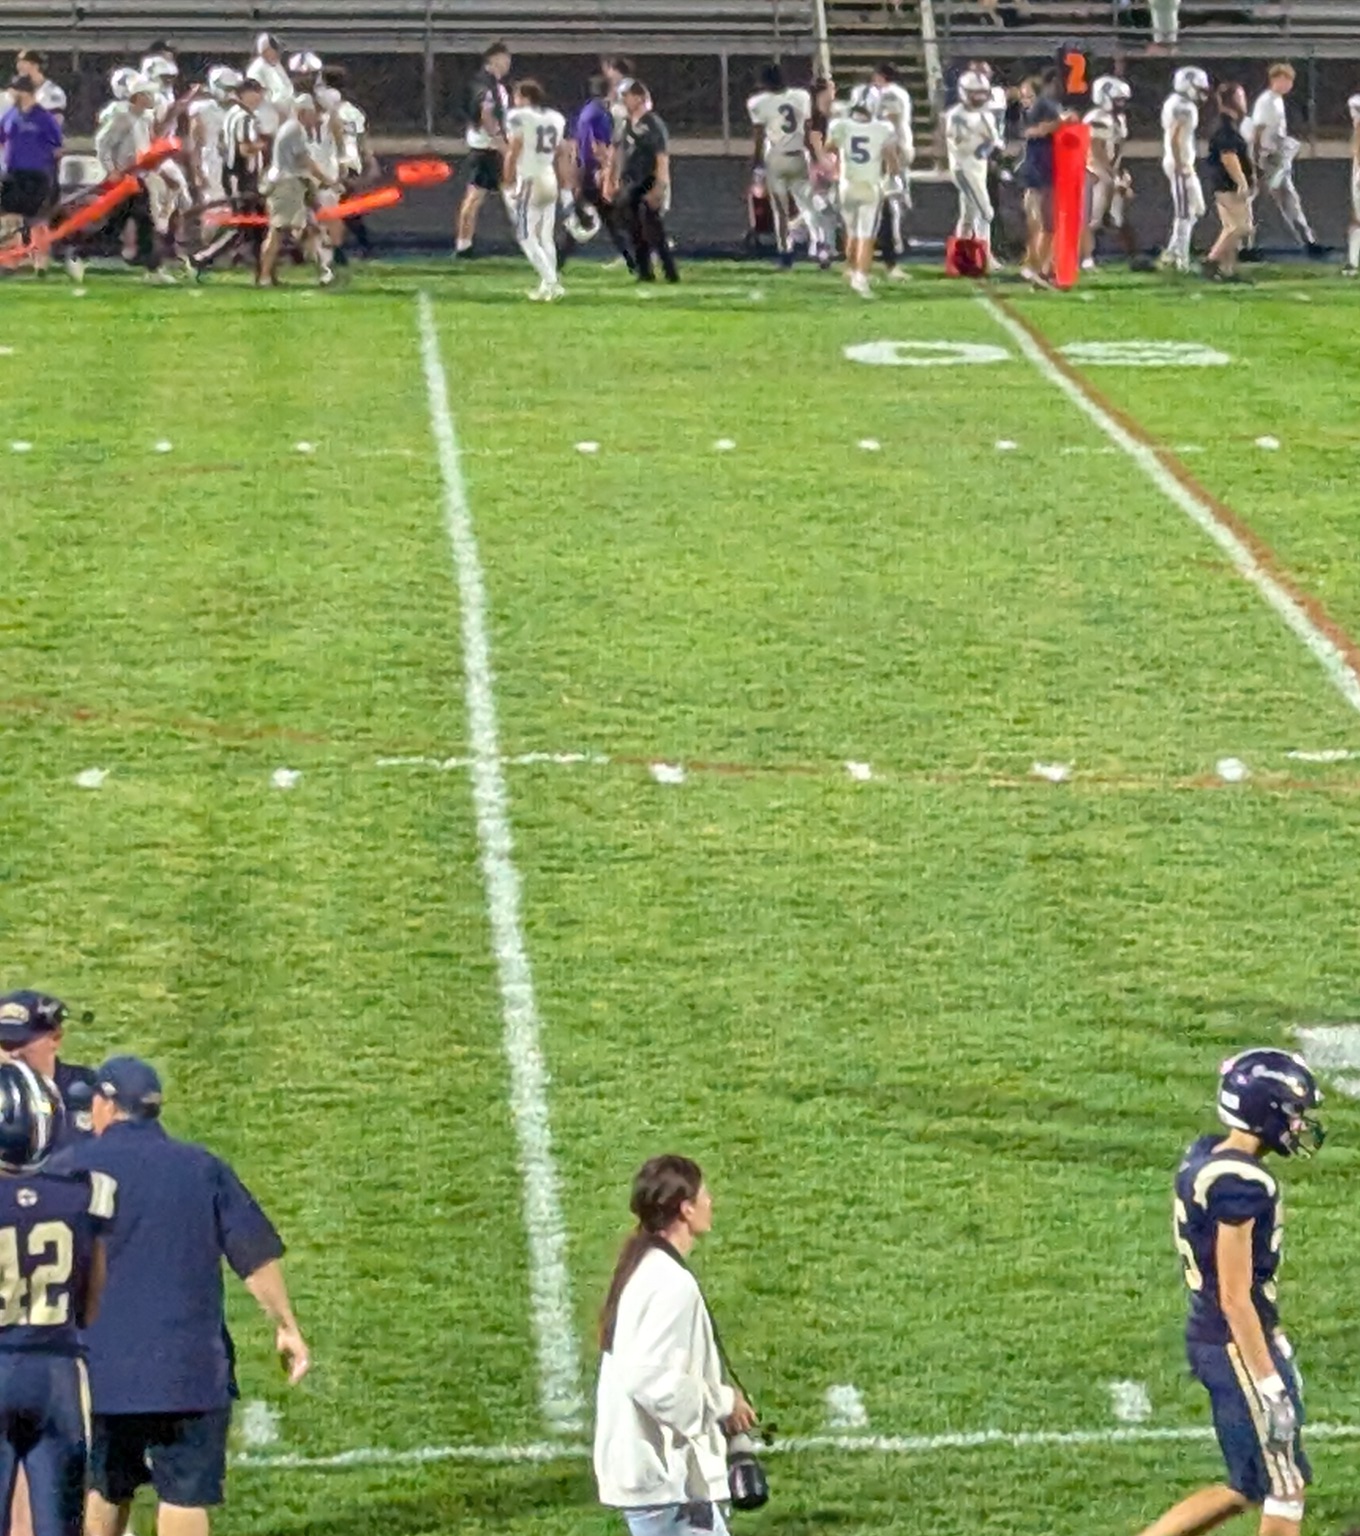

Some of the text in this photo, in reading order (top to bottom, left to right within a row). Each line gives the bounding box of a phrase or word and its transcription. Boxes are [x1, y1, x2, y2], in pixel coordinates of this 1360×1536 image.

[1064, 52, 1089, 95] 2
[536, 124, 558, 154] 13
[849, 135, 870, 164] 5
